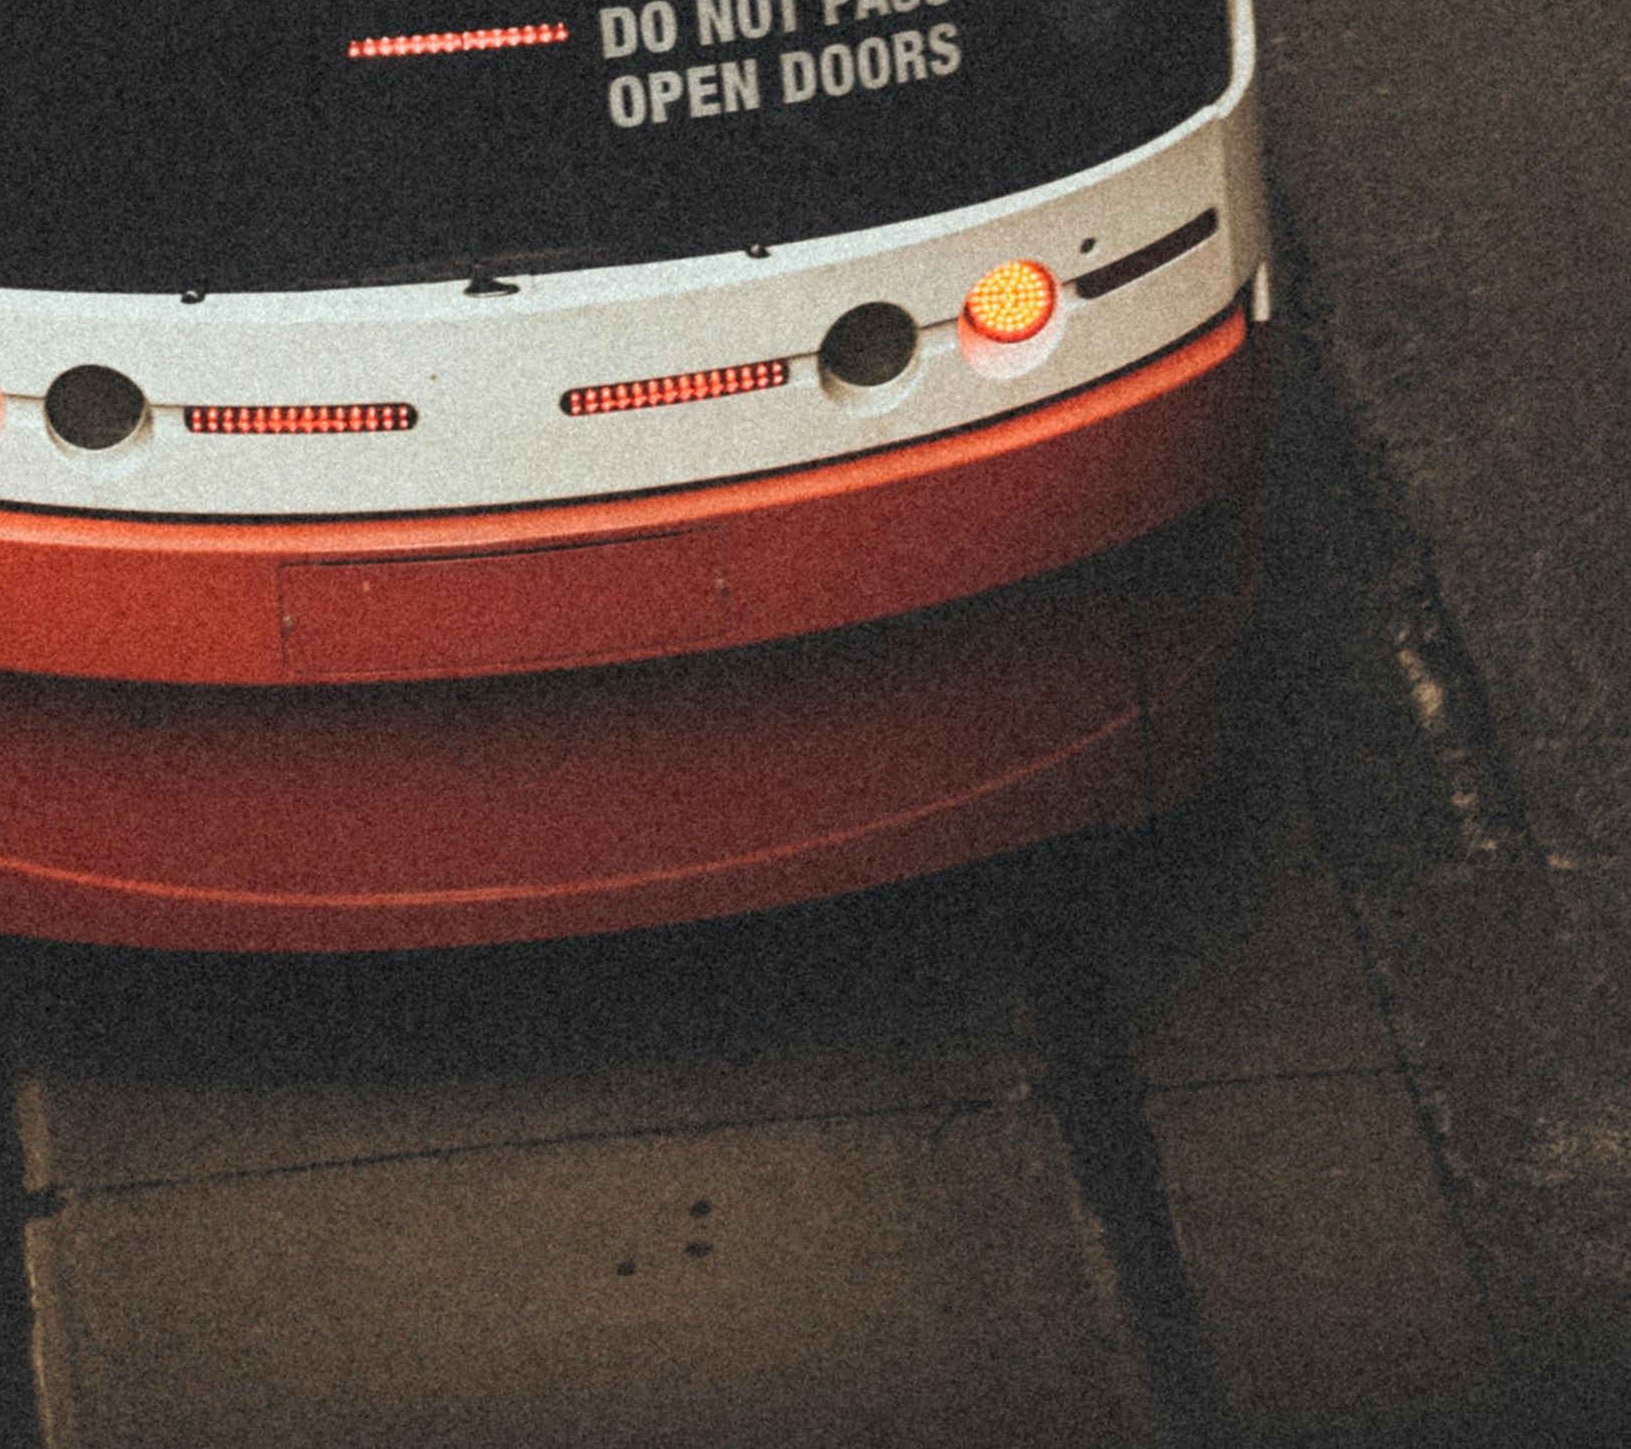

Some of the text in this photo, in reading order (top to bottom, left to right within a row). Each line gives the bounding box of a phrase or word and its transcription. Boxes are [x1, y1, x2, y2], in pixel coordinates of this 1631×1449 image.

[599, 0, 678, 58] DO
[609, 23, 962, 128] OPEN DOORS
